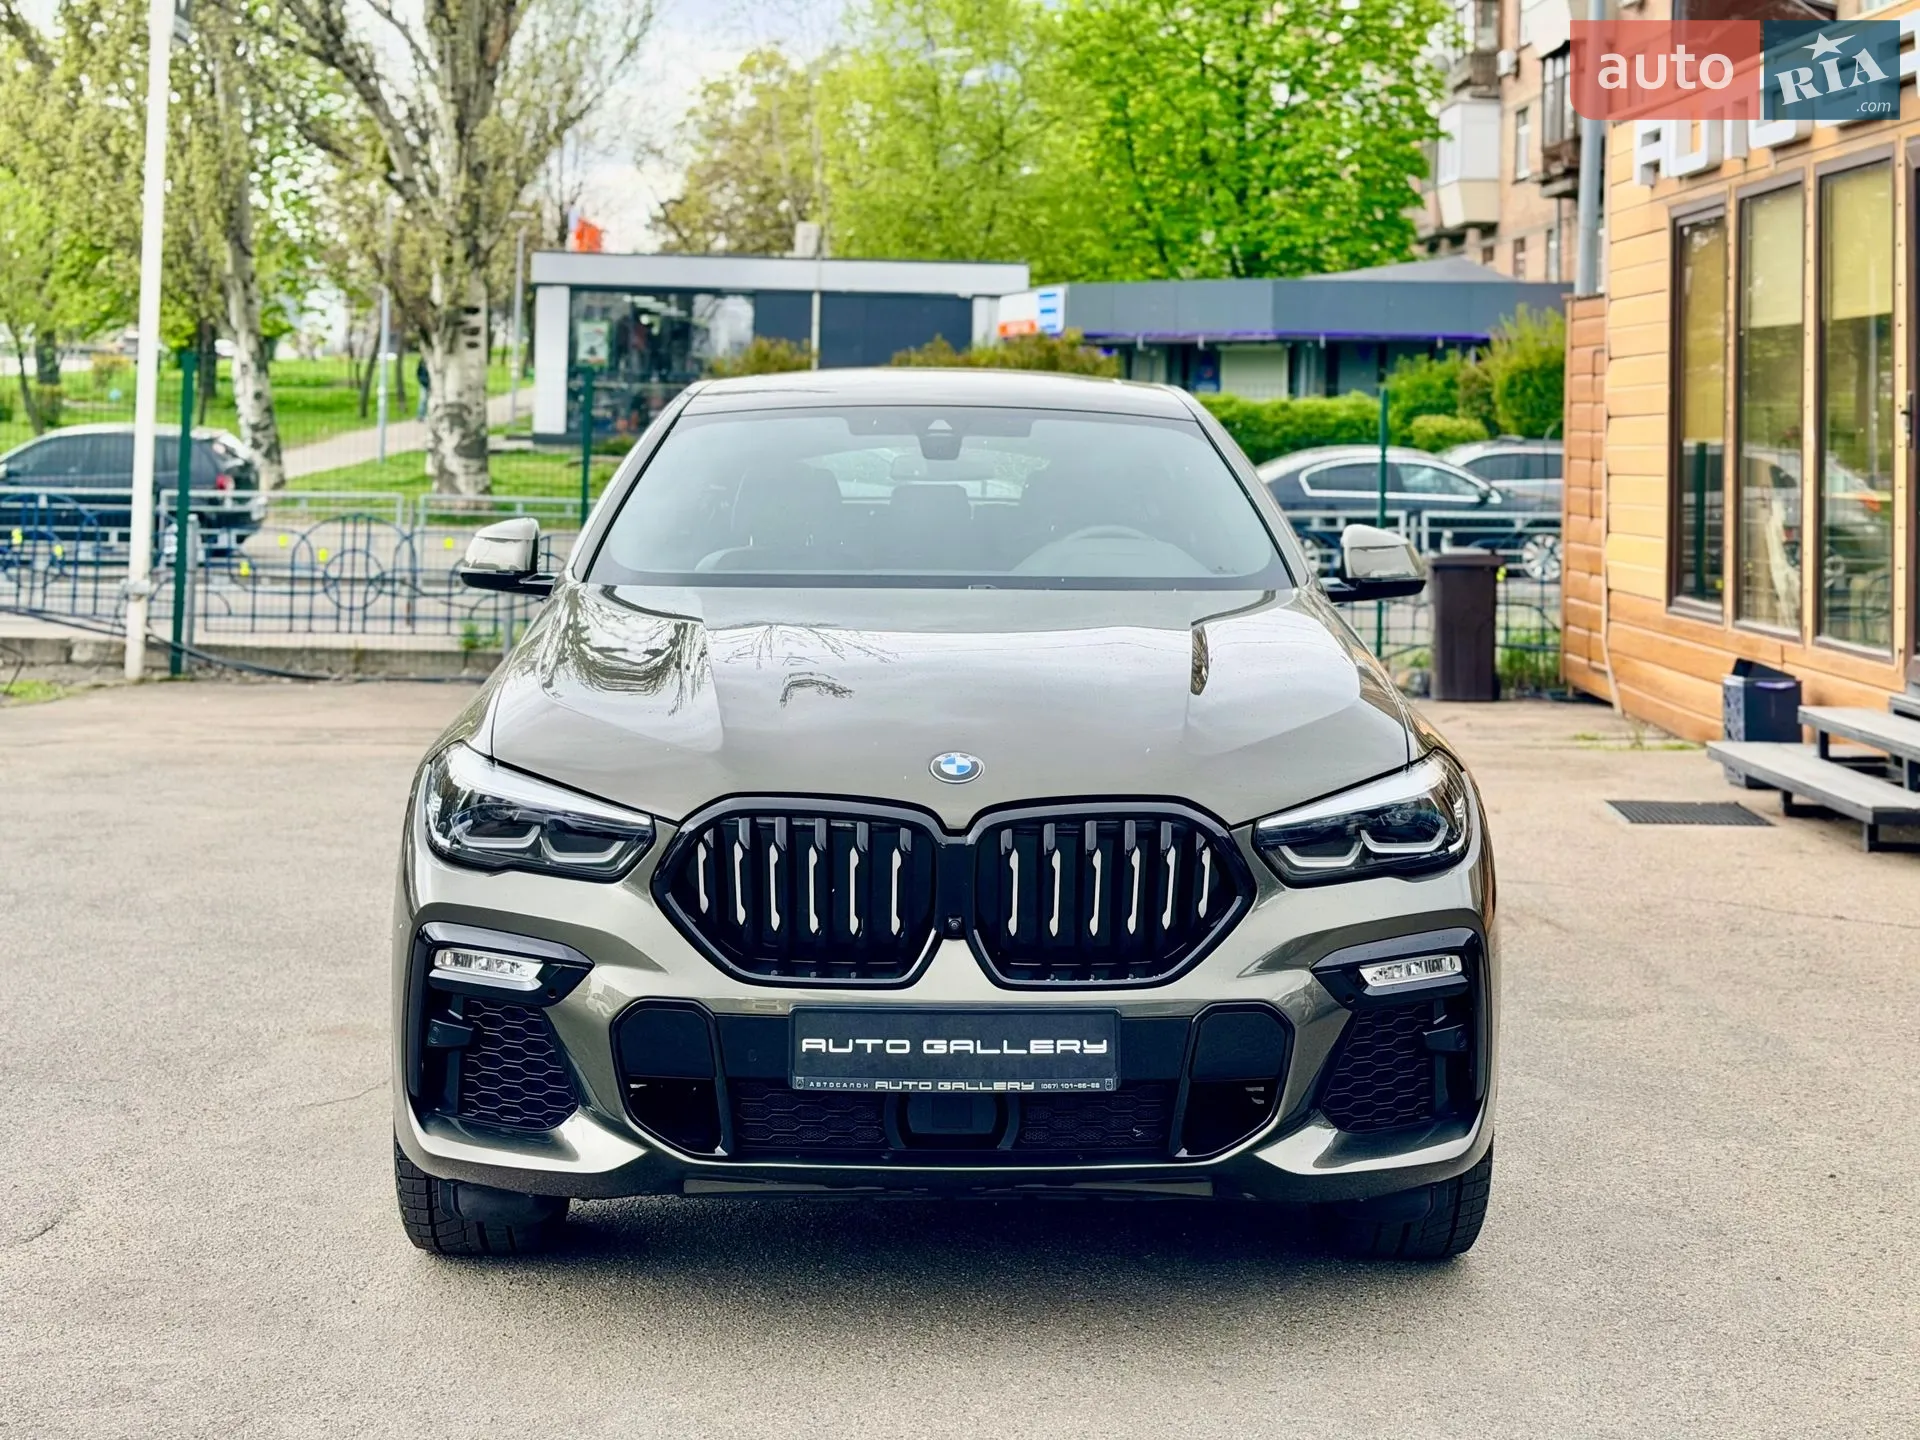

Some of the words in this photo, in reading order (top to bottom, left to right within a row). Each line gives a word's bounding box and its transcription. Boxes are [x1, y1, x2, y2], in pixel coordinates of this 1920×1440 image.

[801, 1038, 911, 1054] AUTO
[922, 1038, 1109, 1055] GALLERY
[874, 1080, 933, 1091] AUTO
[937, 1081, 1036, 1092] GALLERY
